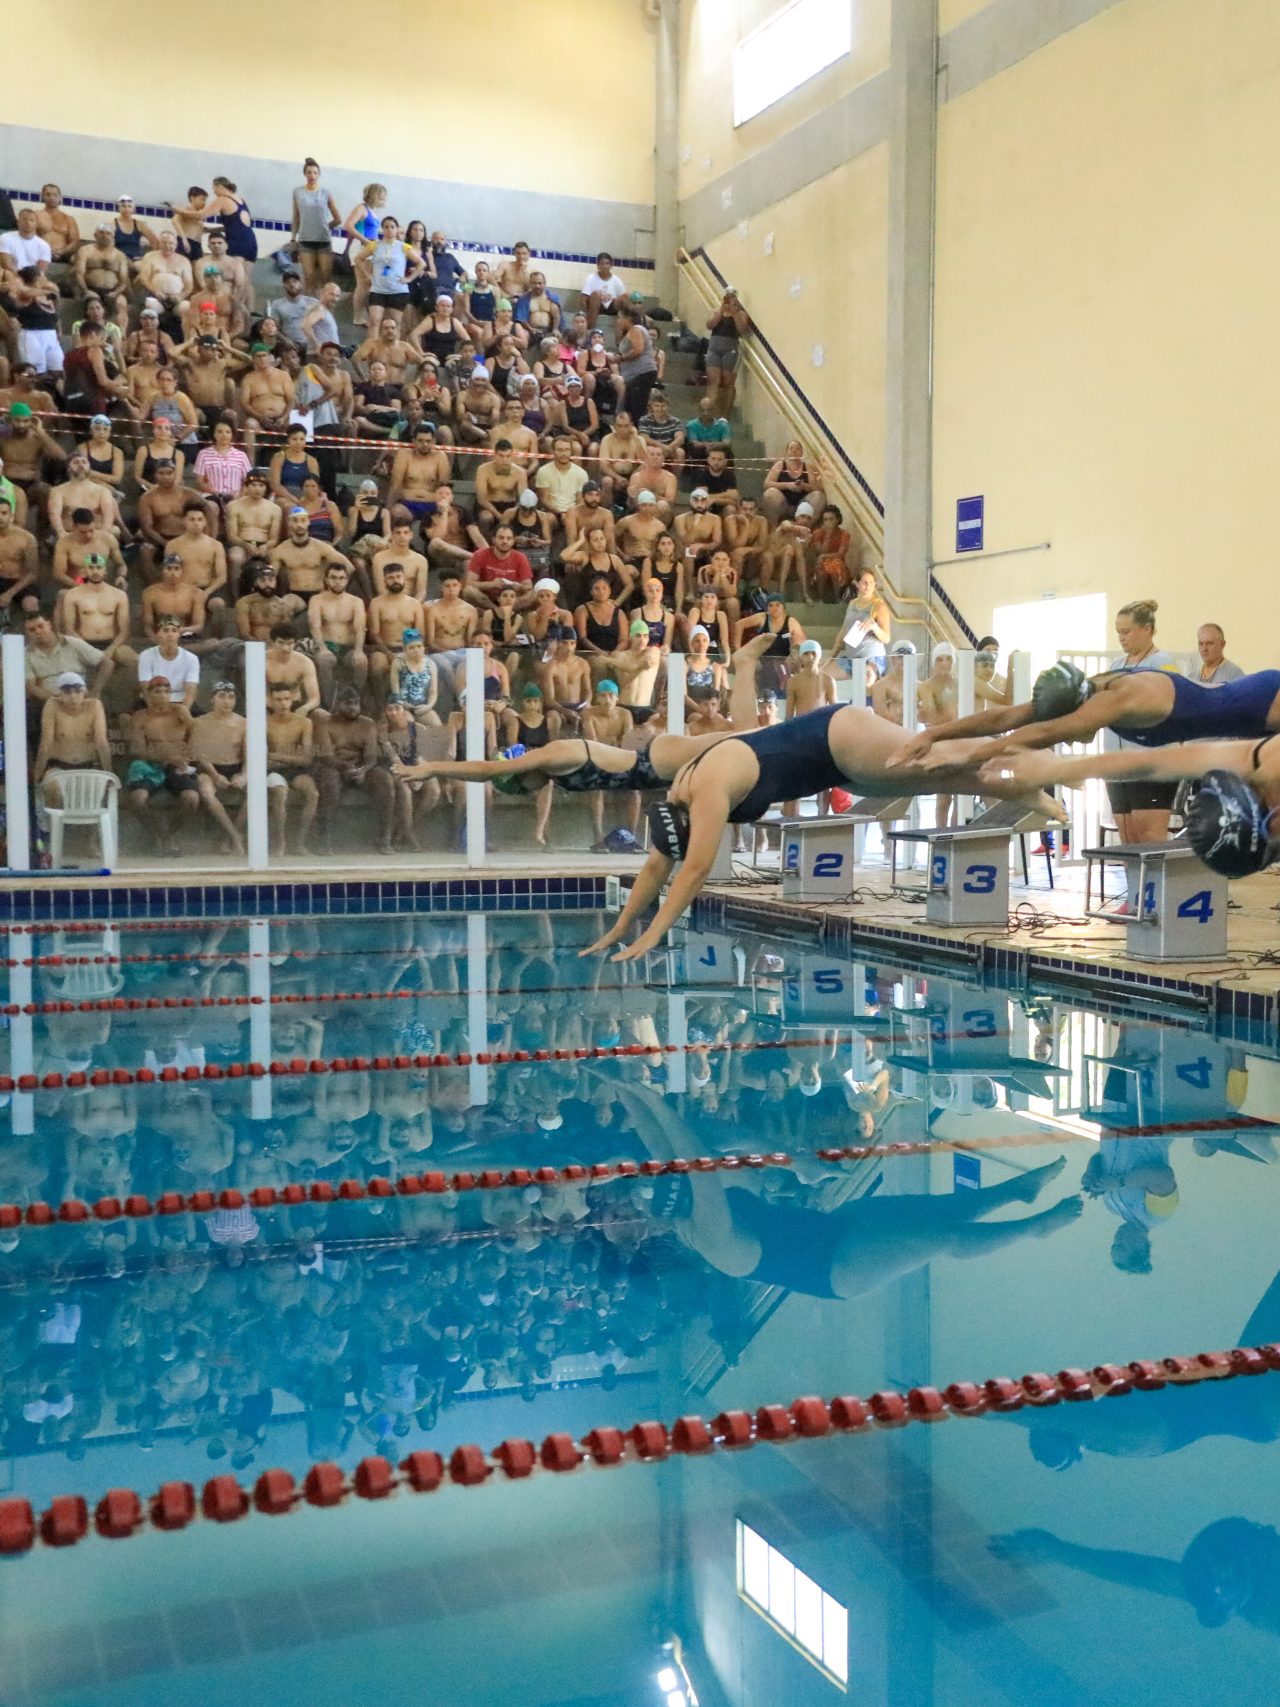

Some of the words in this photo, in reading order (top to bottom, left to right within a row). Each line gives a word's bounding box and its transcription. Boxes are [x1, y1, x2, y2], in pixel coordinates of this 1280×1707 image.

[658, 807, 681, 860] NABAIJI
[787, 844, 800, 868] 2
[813, 853, 843, 877] 2
[932, 856, 946, 884] 3
[963, 865, 997, 893] 3
[1135, 882, 1156, 914] 4
[1177, 891, 1214, 923] 4
